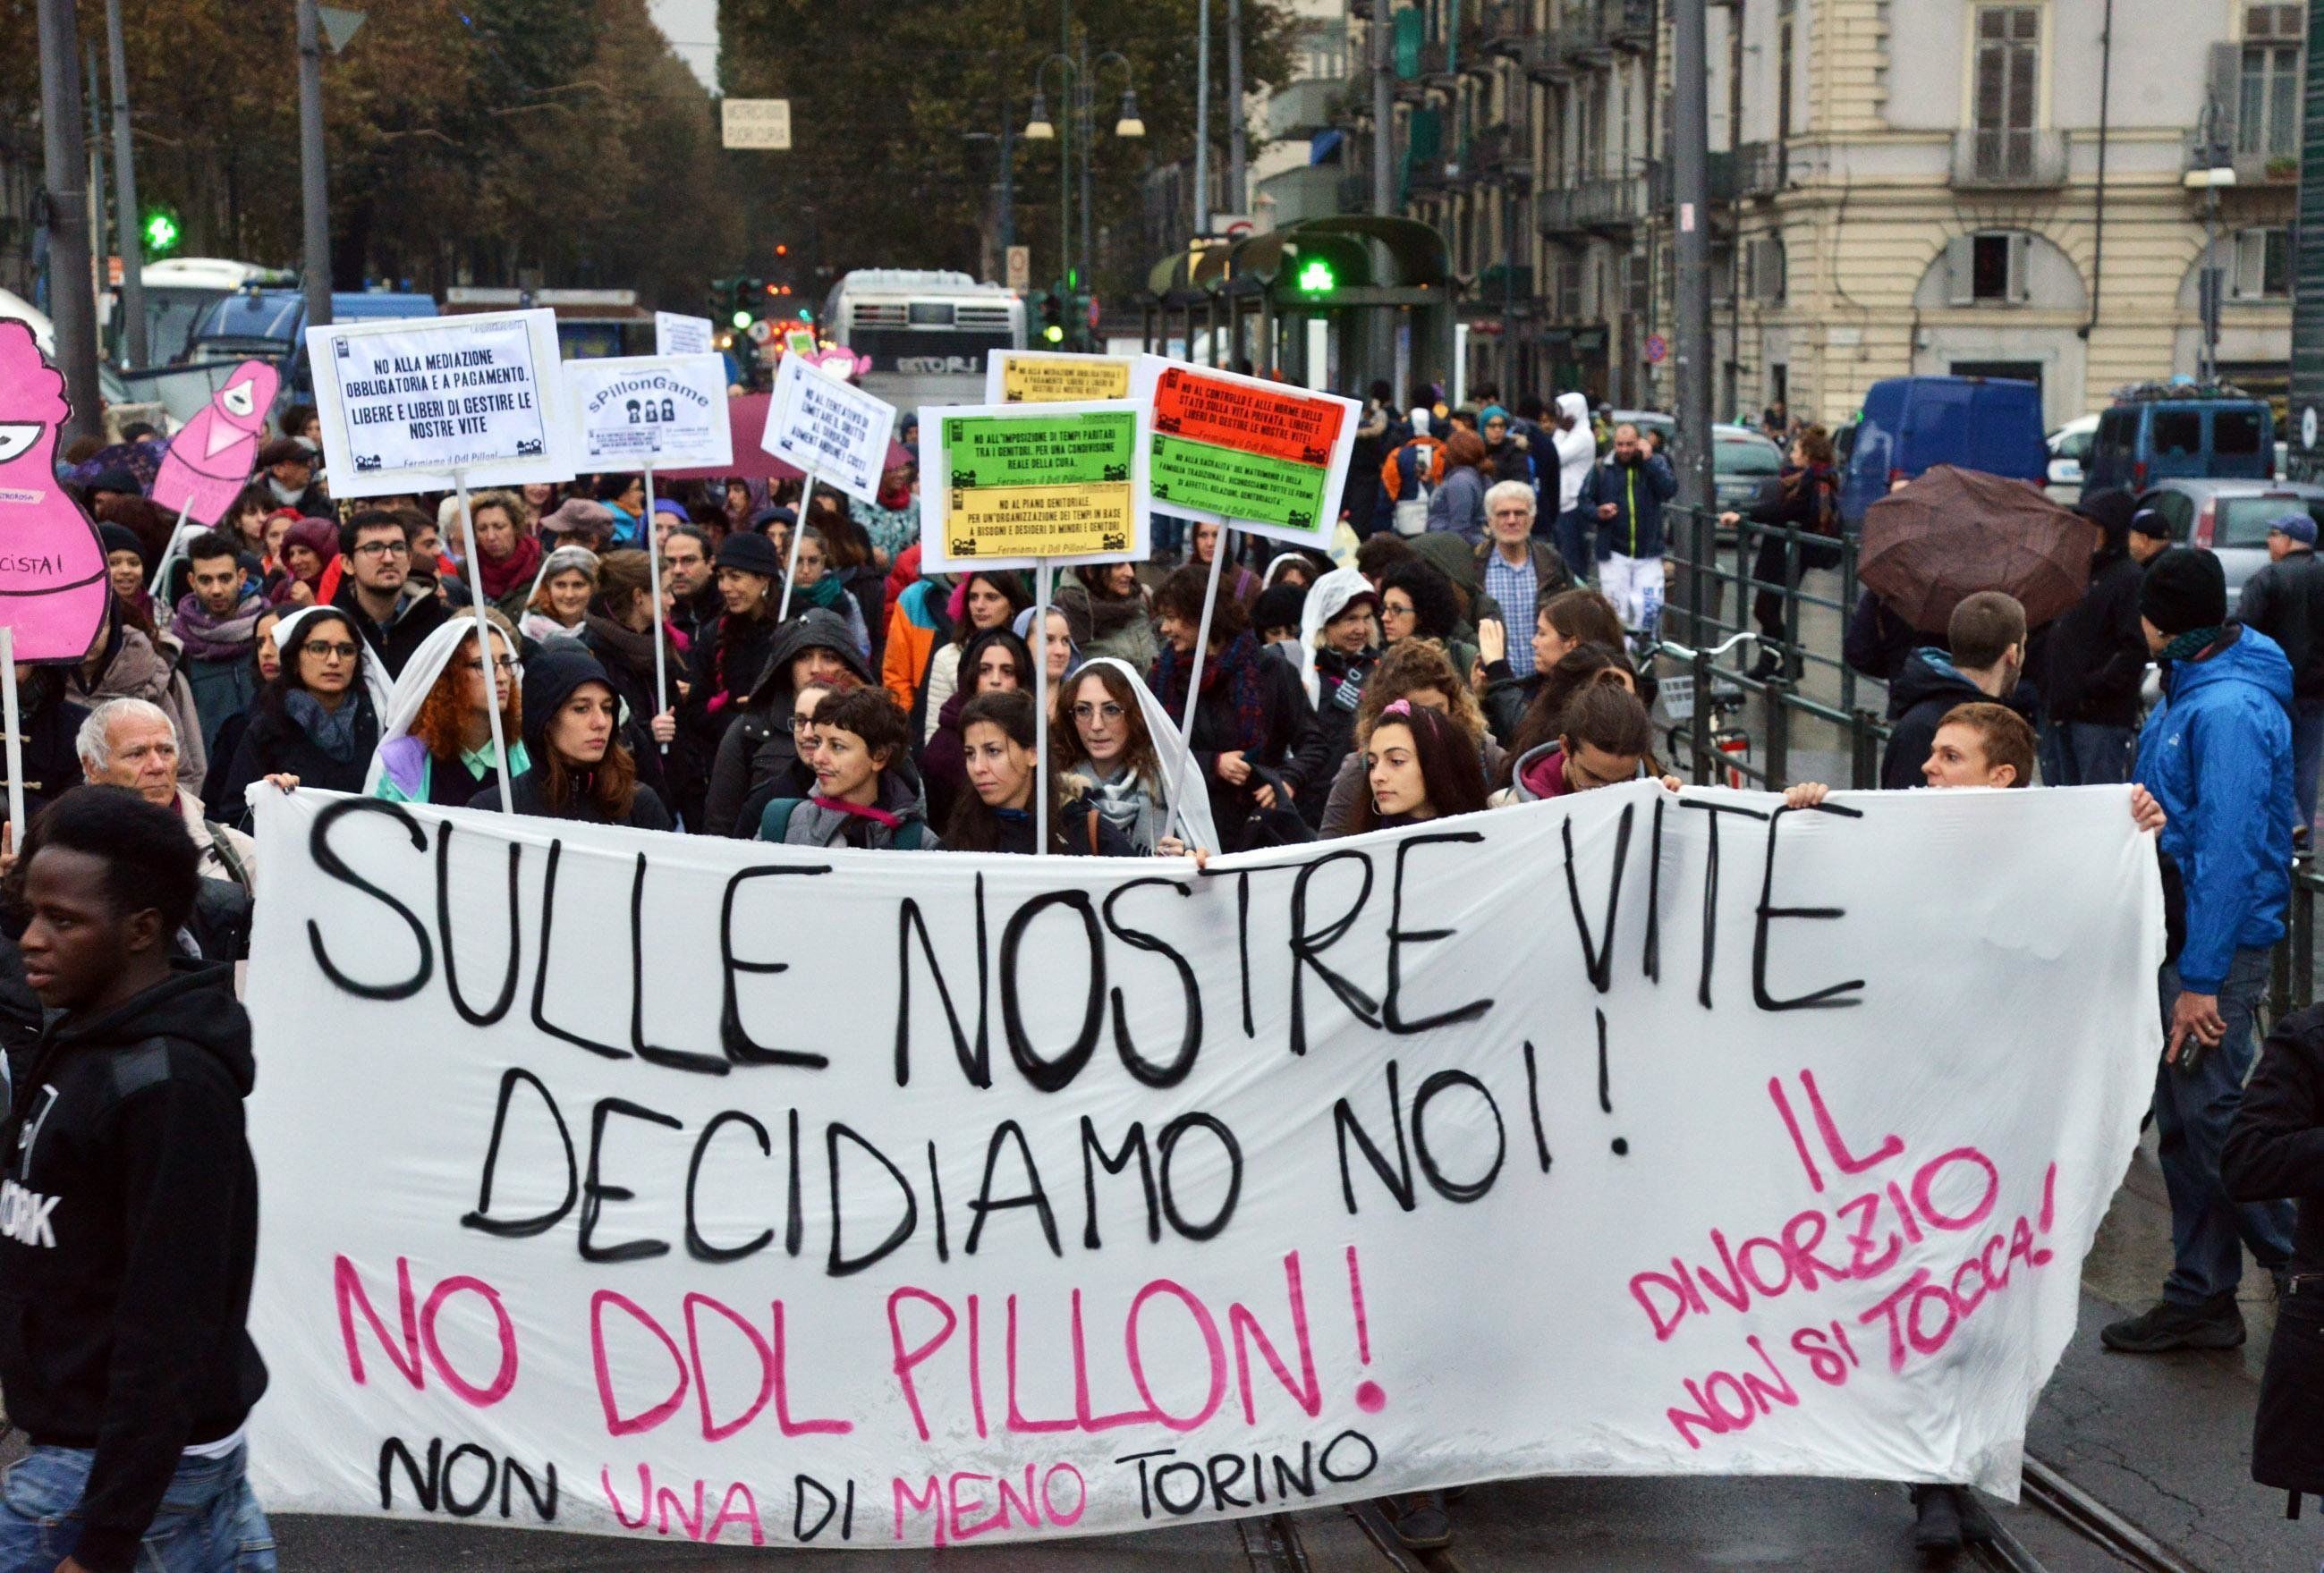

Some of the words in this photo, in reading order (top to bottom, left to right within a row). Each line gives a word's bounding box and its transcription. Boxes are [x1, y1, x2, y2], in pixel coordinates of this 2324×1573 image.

[374, 359, 389, 375] NO
[395, 356, 421, 373] ALLA
[426, 350, 493, 370] MEDIAZIONE
[346, 376, 428, 398] OBBLIGATORIA
[432, 376, 437, 389] E
[443, 375, 450, 389] A
[454, 367, 529, 388] PAGAMENTO.
[589, 376, 708, 413] sPillonGame
[352, 405, 394, 425] LIBERE
[398, 404, 405, 419] E
[408, 401, 445, 419] LIBERI
[448, 399, 460, 416] DI
[464, 395, 514, 414] GESTIRE
[518, 393, 531, 409] LE
[1180, 396, 1204, 408] STATO
[1208, 401, 1229, 413] SULLA
[1232, 406, 1249, 418] VITA
[1289, 419, 1313, 433] LIBERE
[1315, 424, 1319, 435] E
[1182, 383, 1192, 393] NO
[1194, 385, 1203, 395] AL
[1206, 387, 1246, 404] CONTROLLO
[1247, 395, 1252, 405] E
[1255, 397, 1271, 410] ALLE
[1274, 402, 1299, 416] NORME
[1302, 407, 1323, 421] DELLO
[410, 420, 454, 439] NOSTRE
[459, 417, 487, 435] VITE
[974, 434, 983, 444] NO
[987, 431, 1047, 444] ALL'IMPOSIZIONE
[1049, 431, 1056, 442] DI
[1059, 430, 1081, 442] TEMPI
[1183, 410, 1207, 422] LIBERI
[1209, 414, 1217, 425] DI
[1218, 417, 1248, 430] GESTIRE
[1251, 422, 1259, 433] LE
[1260, 425, 1287, 439] NOSTRE
[403, 457, 445, 467] Fermiamo
[976, 447, 990, 458] TRA
[1035, 445, 1048, 455] PER
[1051, 444, 1065, 454] UNA
[1068, 443, 1115, 454] CONDIVISIONE
[1007, 459, 1029, 469] REALE
[1031, 458, 1053, 469] DELLA
[1175, 453, 1183, 461] NO
[1185, 455, 1198, 464] ALLA
[968, 513, 980, 523] PER
[1060, 511, 1071, 521] DEI
[1073, 510, 1091, 520] TEMPI
[1094, 510, 1101, 519] IN
[1103, 508, 1121, 518] BASE
[999, 500, 1008, 510] NO
[1012, 499, 1020, 509] AL
[1022, 498, 1044, 509] PIANO
[969, 526, 974, 536] A
[978, 525, 1006, 536] BISOGNI
[1009, 525, 1013, 535] E
[1015, 523, 1047, 535] DESIDERI
[1049, 523, 1056, 534] DI
[1058, 522, 1081, 534] MINORI
[1084, 522, 1088, 532] E
[309, 797, 834, 1076] SULLE
[894, 832, 1494, 1093] NOSTRE
[1563, 797, 1865, 1011] VITE
[461, 1067, 1243, 1278] DECIDIAMO
[1335, 1006, 1630, 1214] NOI!
[1768, 1069, 1905, 1193] IL
[1629, 1146, 1999, 1342] DIVORZIO
[1667, 1335, 1800, 1450] NON
[1790, 1320, 1860, 1387] SI
[1858, 1161, 2057, 1374] TOCCA!
[335, 1254, 519, 1408] NO
[591, 1289, 854, 1442] DDL
[886, 1245, 1387, 1442] PILLON!
[377, 1436, 556, 1520] NON
[600, 1462, 766, 1545] UNA
[795, 1474, 854, 1543] DI
[893, 1462, 1086, 1548] MENO
[1115, 1430, 1378, 1519] TORINO
